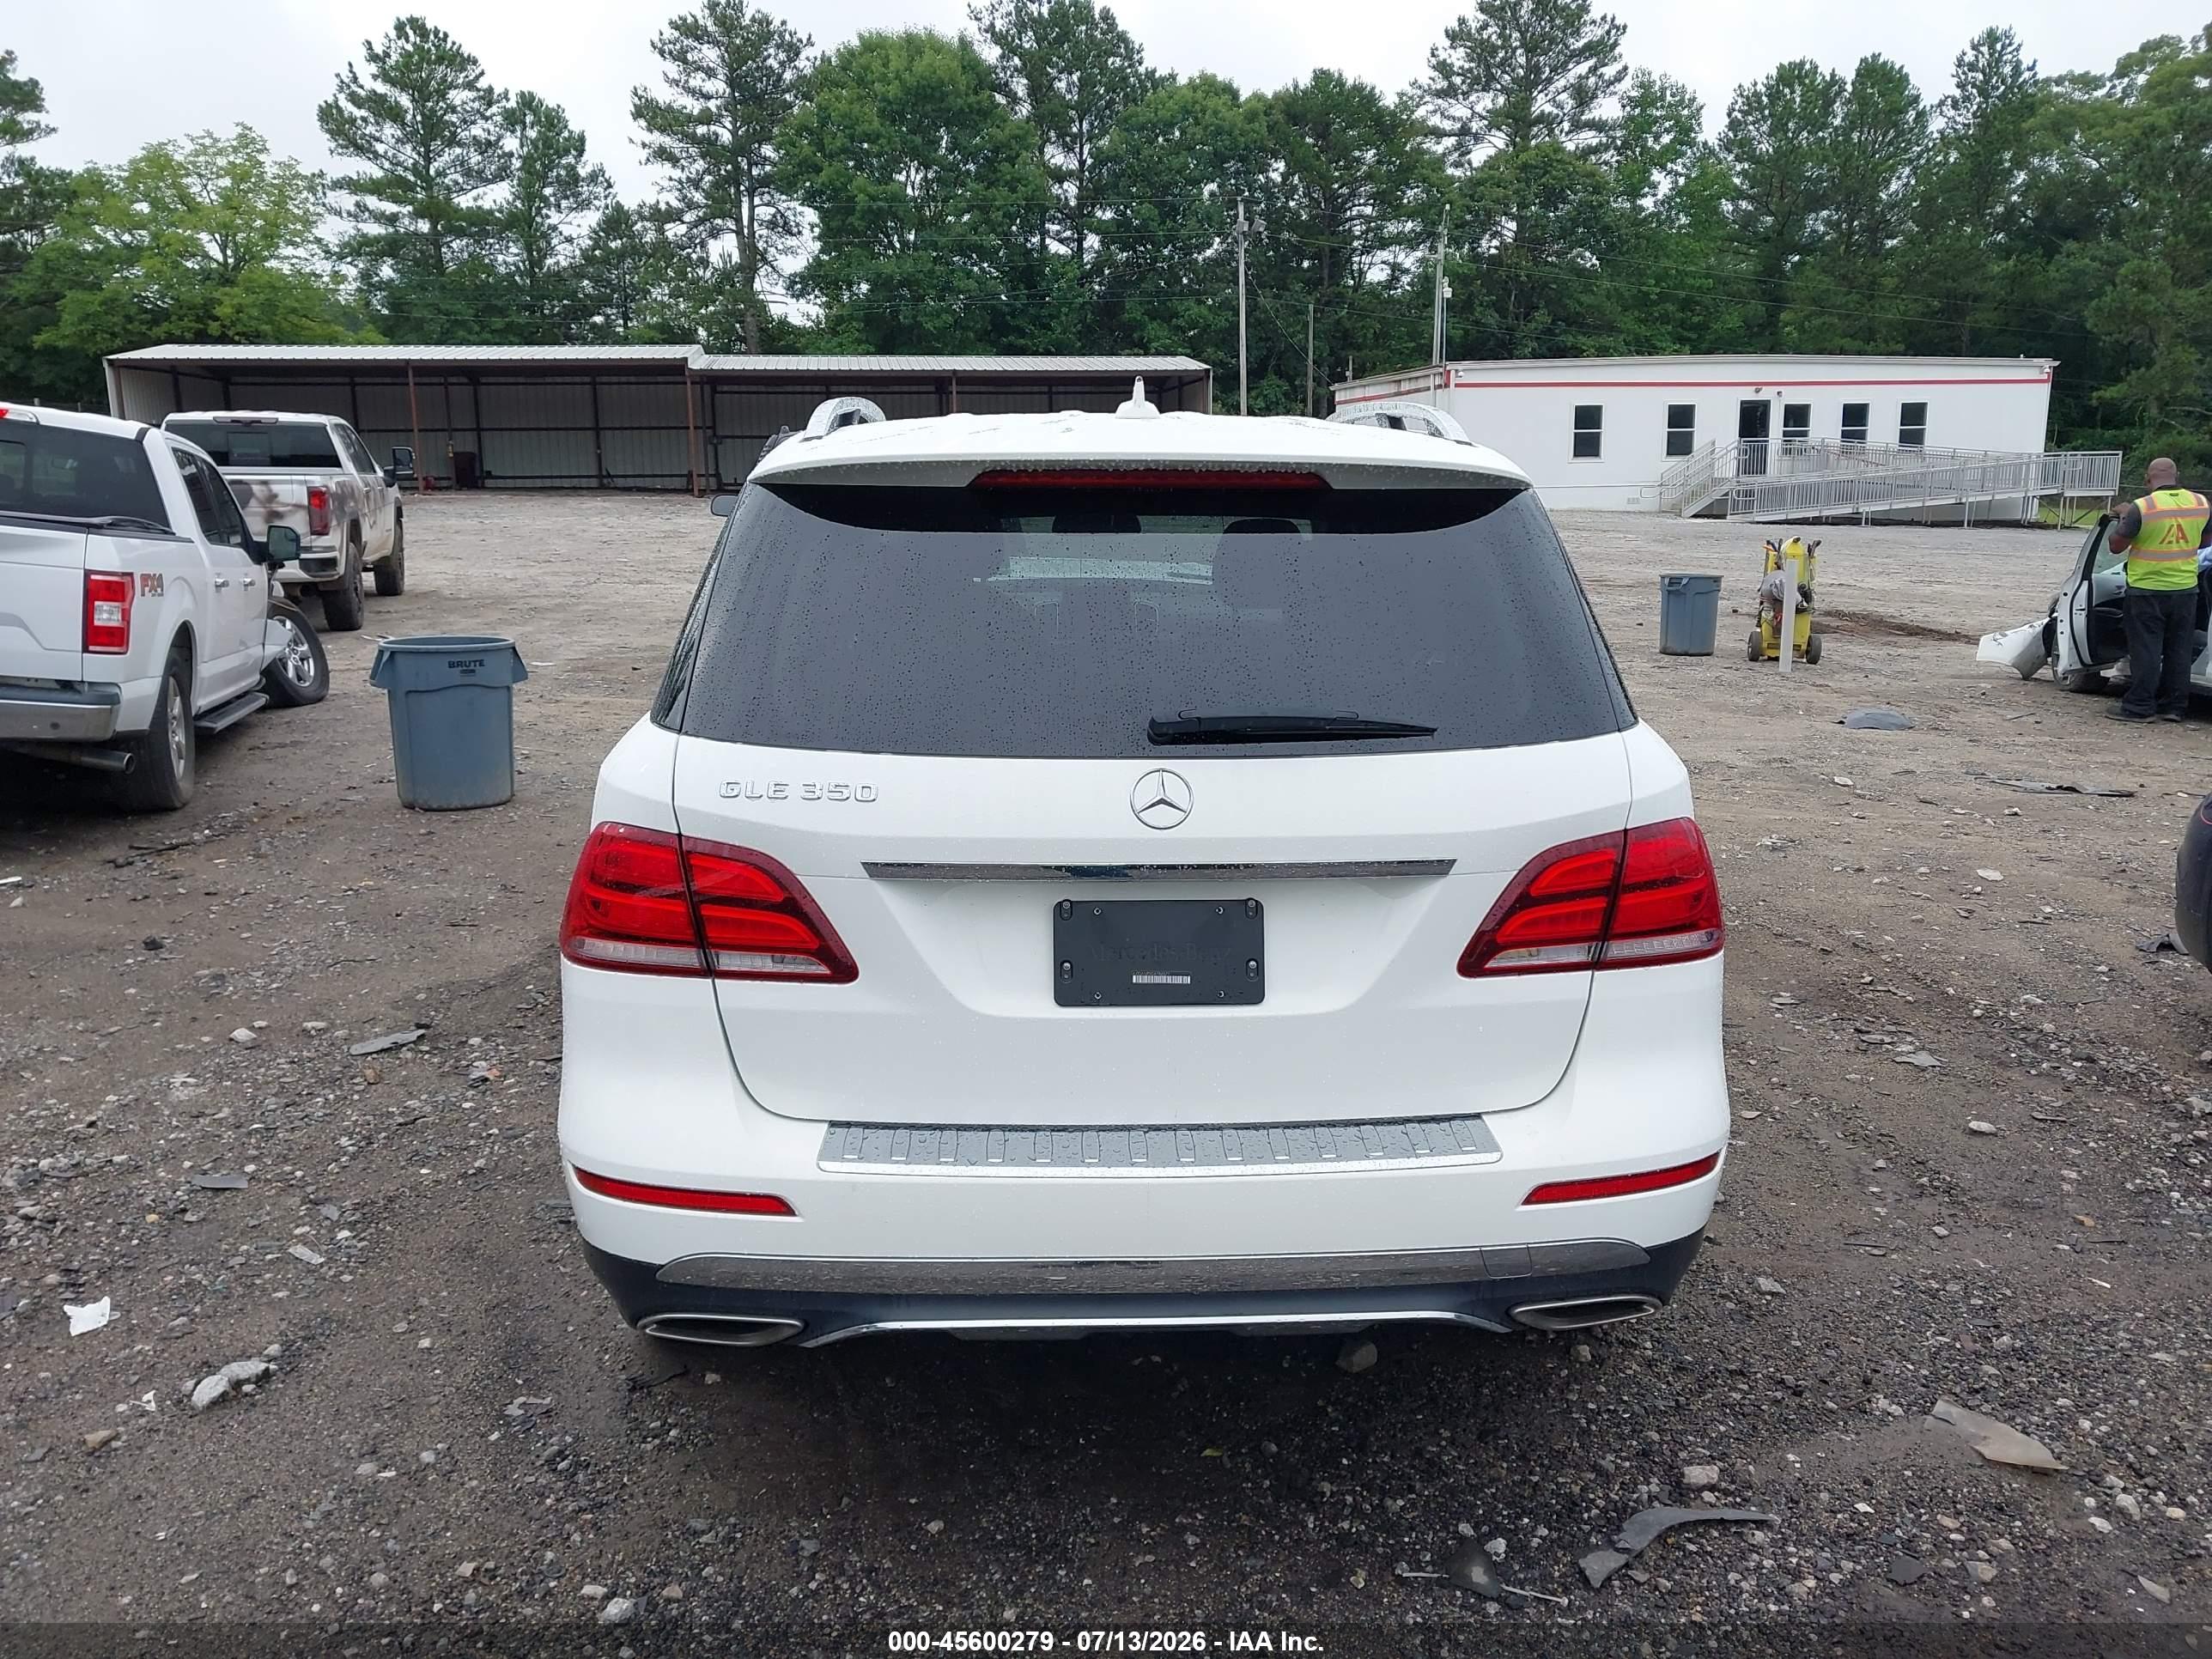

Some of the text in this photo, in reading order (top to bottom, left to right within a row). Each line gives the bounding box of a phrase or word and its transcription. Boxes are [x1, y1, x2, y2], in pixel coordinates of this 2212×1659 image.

[139, 573, 164, 597] FX4
[447, 659, 485, 669] BRUTE
[719, 780, 879, 803] GLE 350
